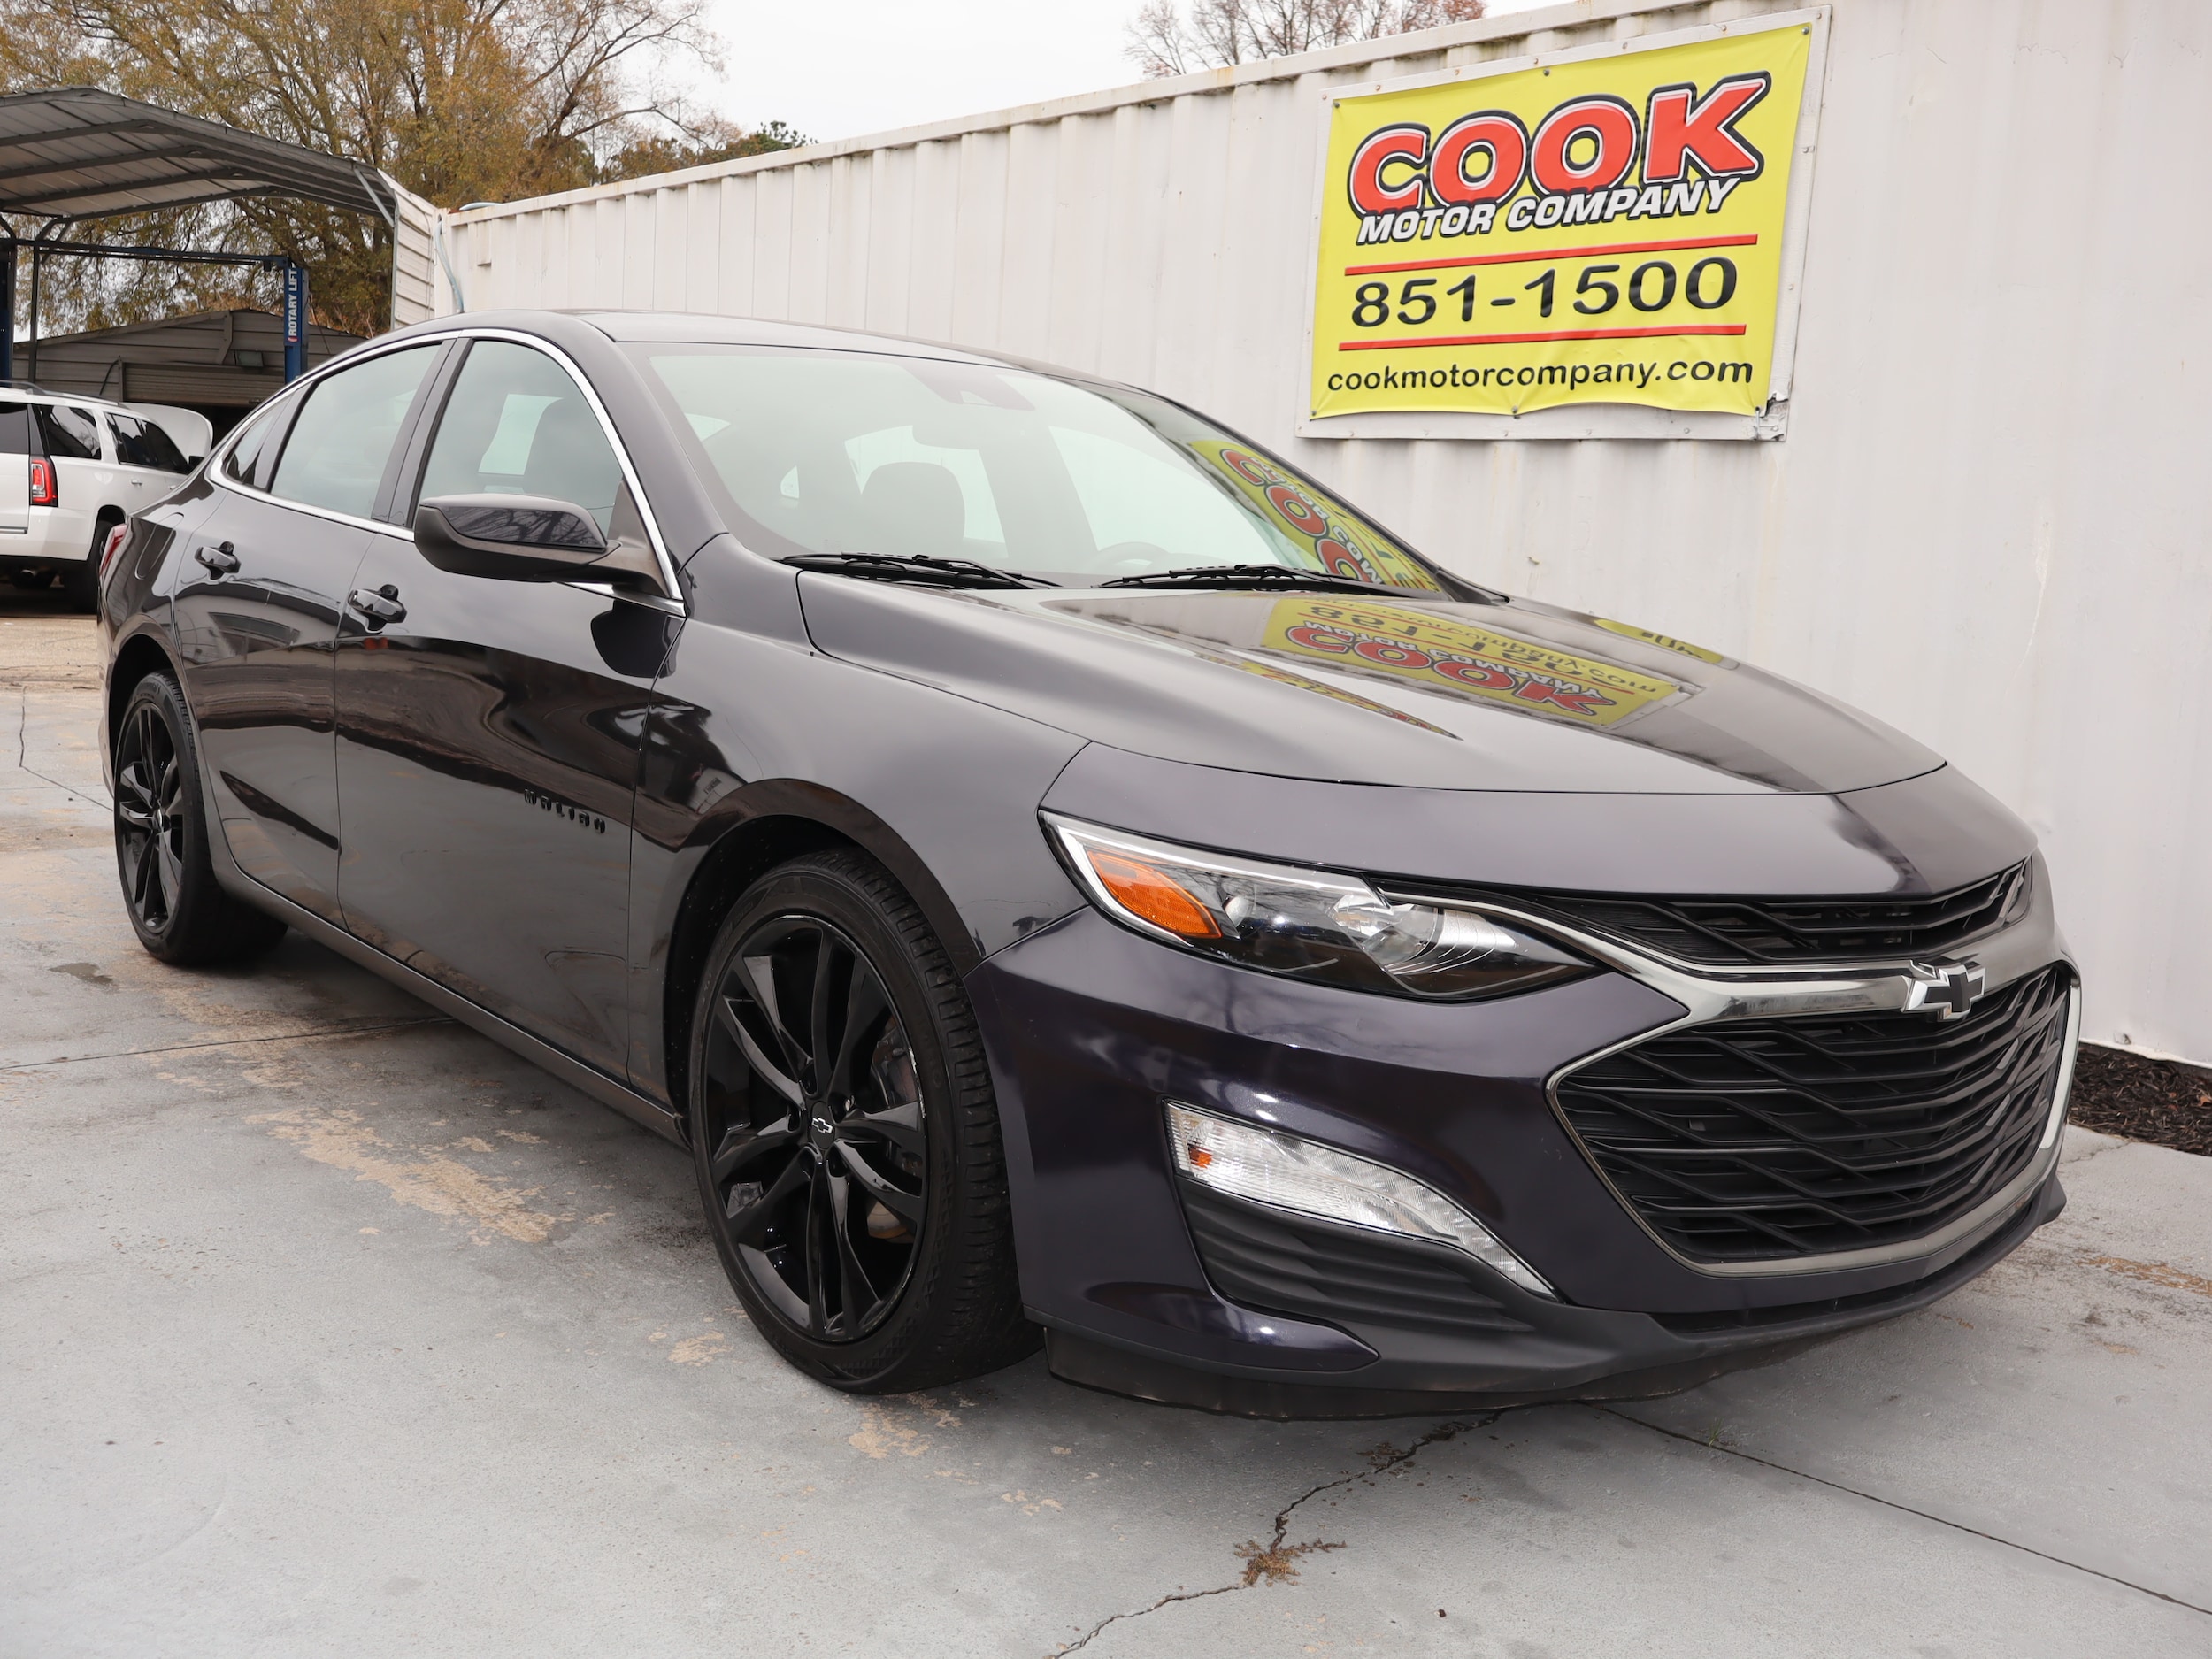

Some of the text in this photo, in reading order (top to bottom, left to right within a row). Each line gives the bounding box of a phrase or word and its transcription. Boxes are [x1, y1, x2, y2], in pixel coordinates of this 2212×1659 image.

[1348, 70, 1772, 219] COOK
[1355, 176, 1742, 245] MOTOR COMPANY
[288, 268, 297, 336] ROTARY LIFT
[1350, 256, 1738, 328] 851-1500
[1327, 359, 1754, 392] cookmotorcompany.com
